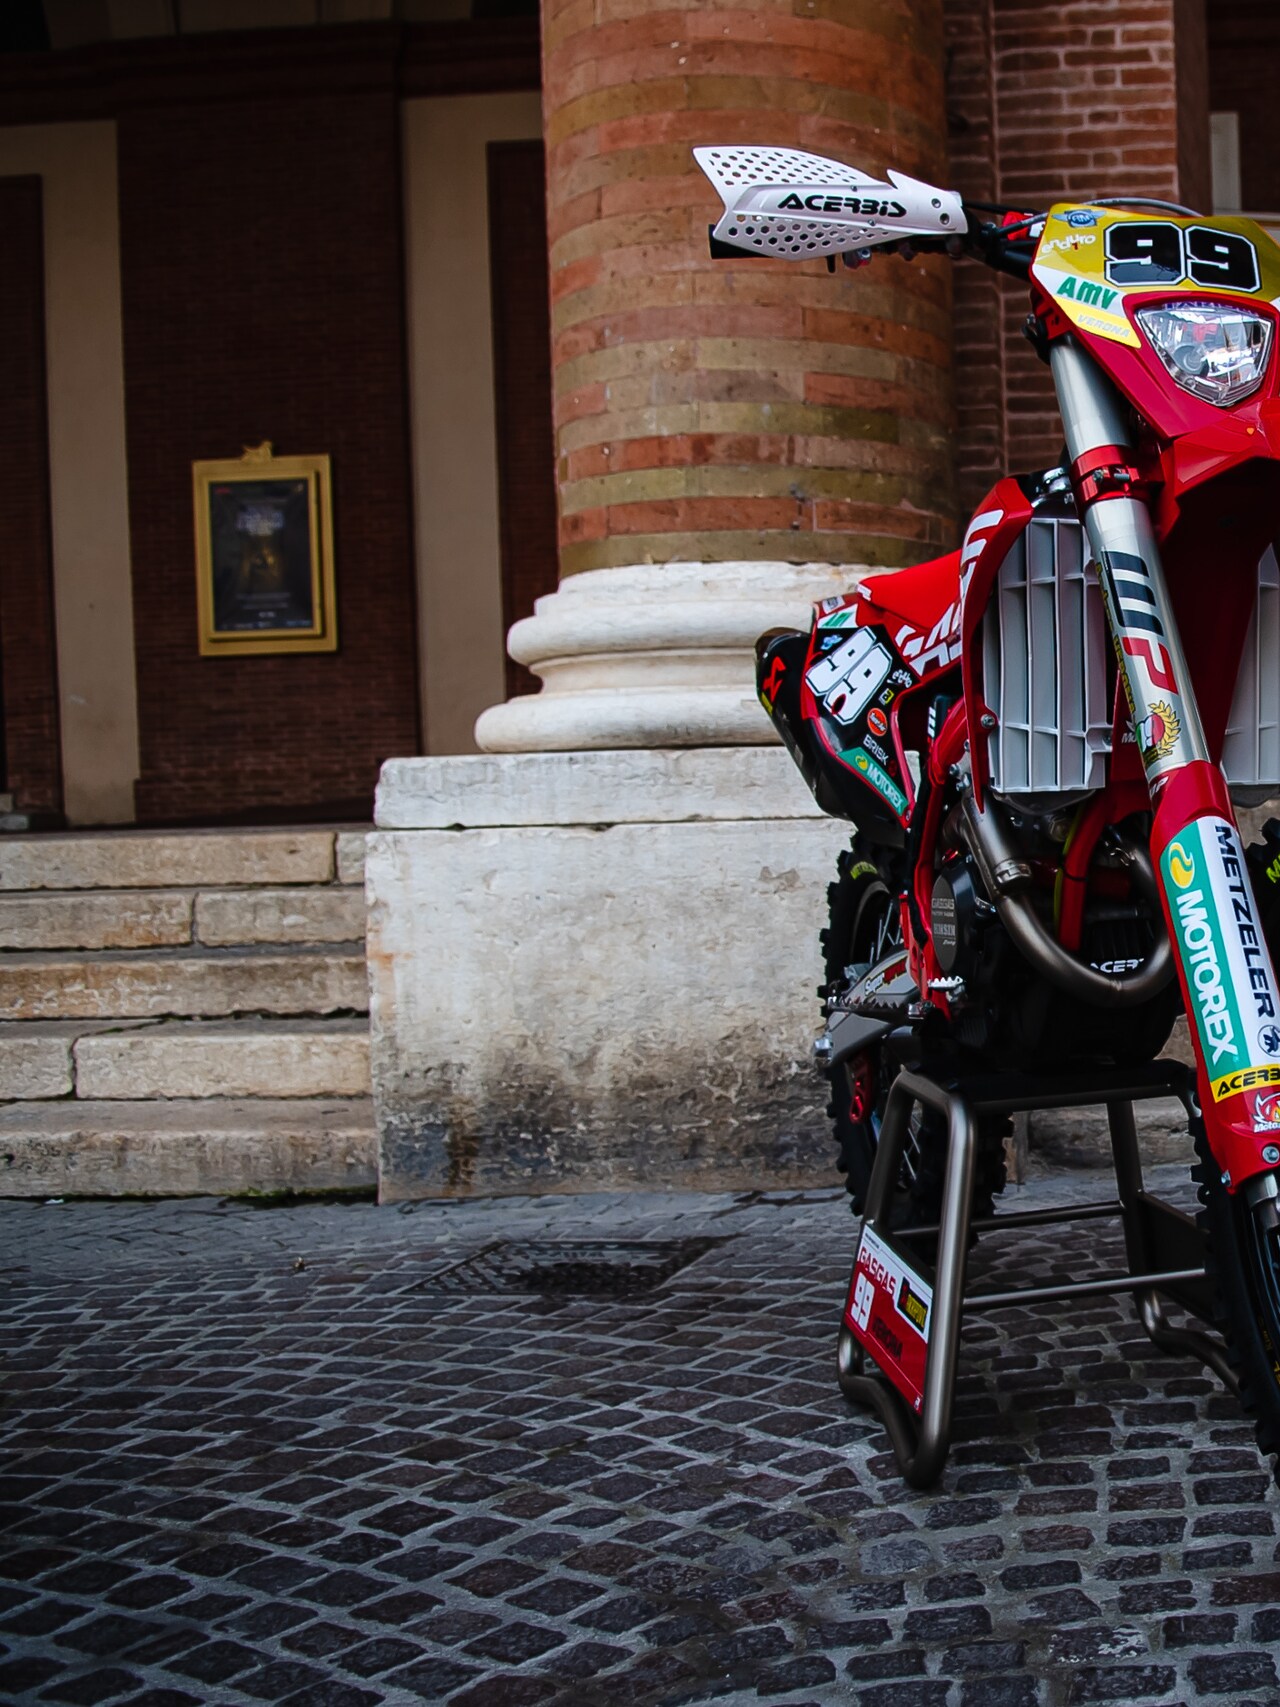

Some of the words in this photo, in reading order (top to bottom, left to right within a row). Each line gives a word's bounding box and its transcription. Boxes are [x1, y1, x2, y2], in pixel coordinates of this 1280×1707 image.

[778, 193, 907, 218] ACERBIS
[1041, 233, 1096, 254] enduro
[1104, 220, 1262, 293] 99
[1057, 276, 1118, 310] AMV
[1077, 313, 1130, 338] VERONA
[1101, 550, 1179, 695] WP
[805, 626, 893, 725] 99
[863, 733, 890, 766] BRISK
[866, 763, 904, 809] MOTOREX
[1215, 825, 1276, 1019] METZELER
[1176, 889, 1238, 1066] MOTOREX
[857, 1246, 897, 1295] GASGAS
[850, 1272, 875, 1332] 99
